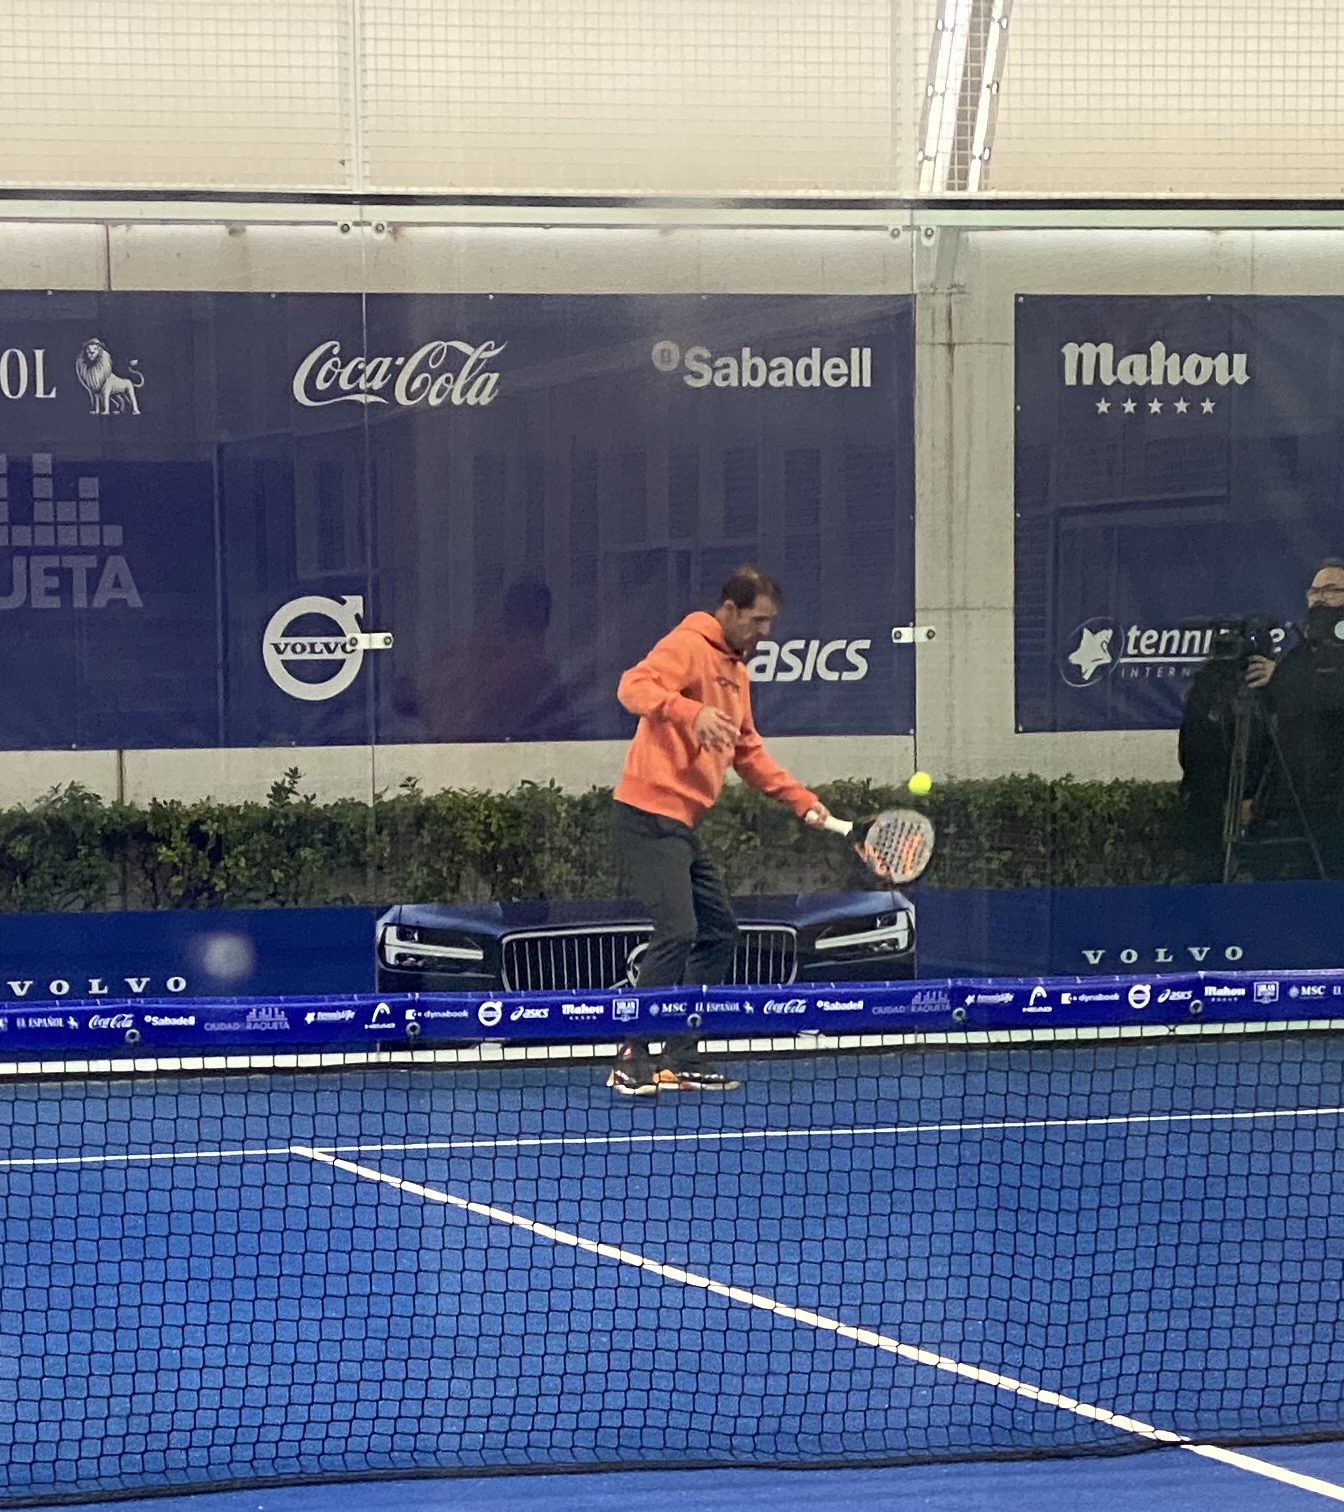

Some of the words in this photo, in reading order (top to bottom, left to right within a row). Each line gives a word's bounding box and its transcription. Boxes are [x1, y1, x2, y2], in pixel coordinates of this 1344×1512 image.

[683, 346, 872, 388] Sabadell
[1060, 340, 1251, 387] Mahou
[292, 339, 509, 407] Coca-Cola
[1082, 944, 1245, 966] VOLVO
[6, 977, 187, 997] VOLVO
[1204, 986, 1246, 997] Mahou
[1301, 985, 1326, 996] MSC
[1078, 993, 1120, 1004] dynabook
[562, 1004, 605, 1015] Mahou
[661, 1002, 688, 1013] MSC
[763, 999, 807, 1014] Coca-Cola
[823, 1001, 864, 1012] Sabadell
[423, 1009, 469, 1019] dynabook
[28, 1016, 64, 1028] ESPAÑOL
[88, 1013, 135, 1031] Coca-Cola
[152, 1016, 196, 1027] Sabadell
